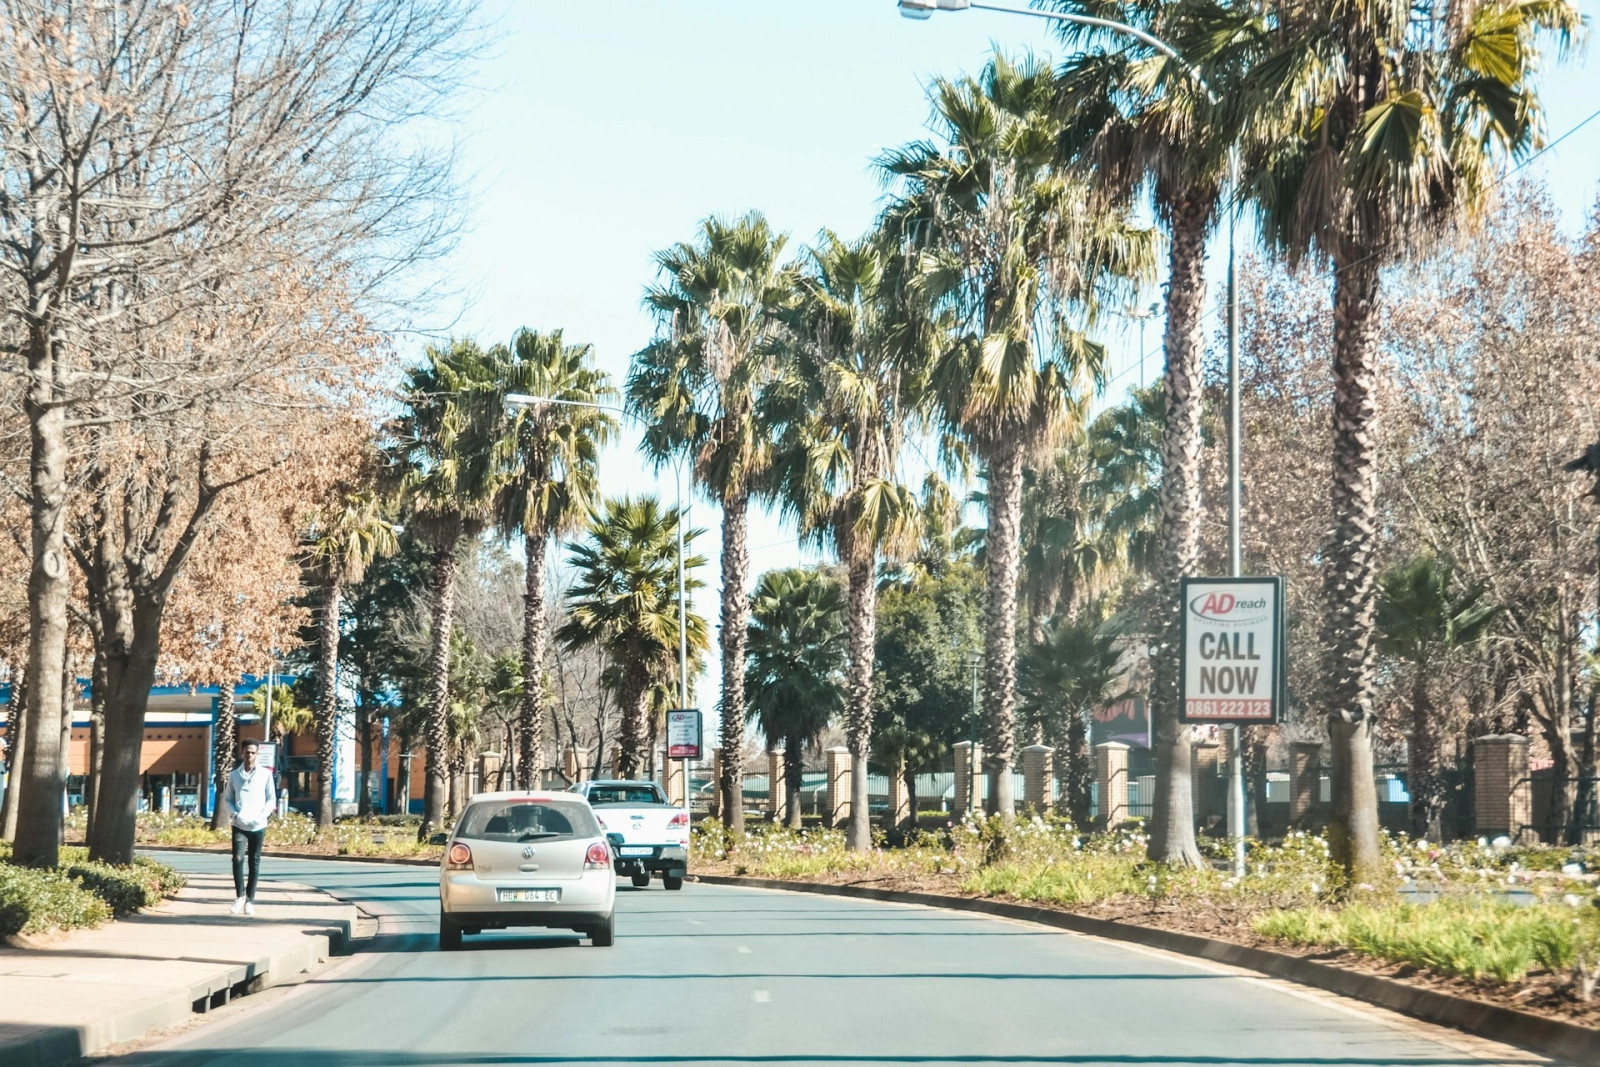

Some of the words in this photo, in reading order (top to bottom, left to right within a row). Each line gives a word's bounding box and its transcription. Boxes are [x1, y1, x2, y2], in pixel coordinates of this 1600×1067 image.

[1199, 632, 1260, 660] CALL
[1200, 666, 1258, 694] NOW
[1186, 701, 1217, 715] 0861
[1220, 701, 1245, 715] 222
[1247, 701, 1270, 715] 123
